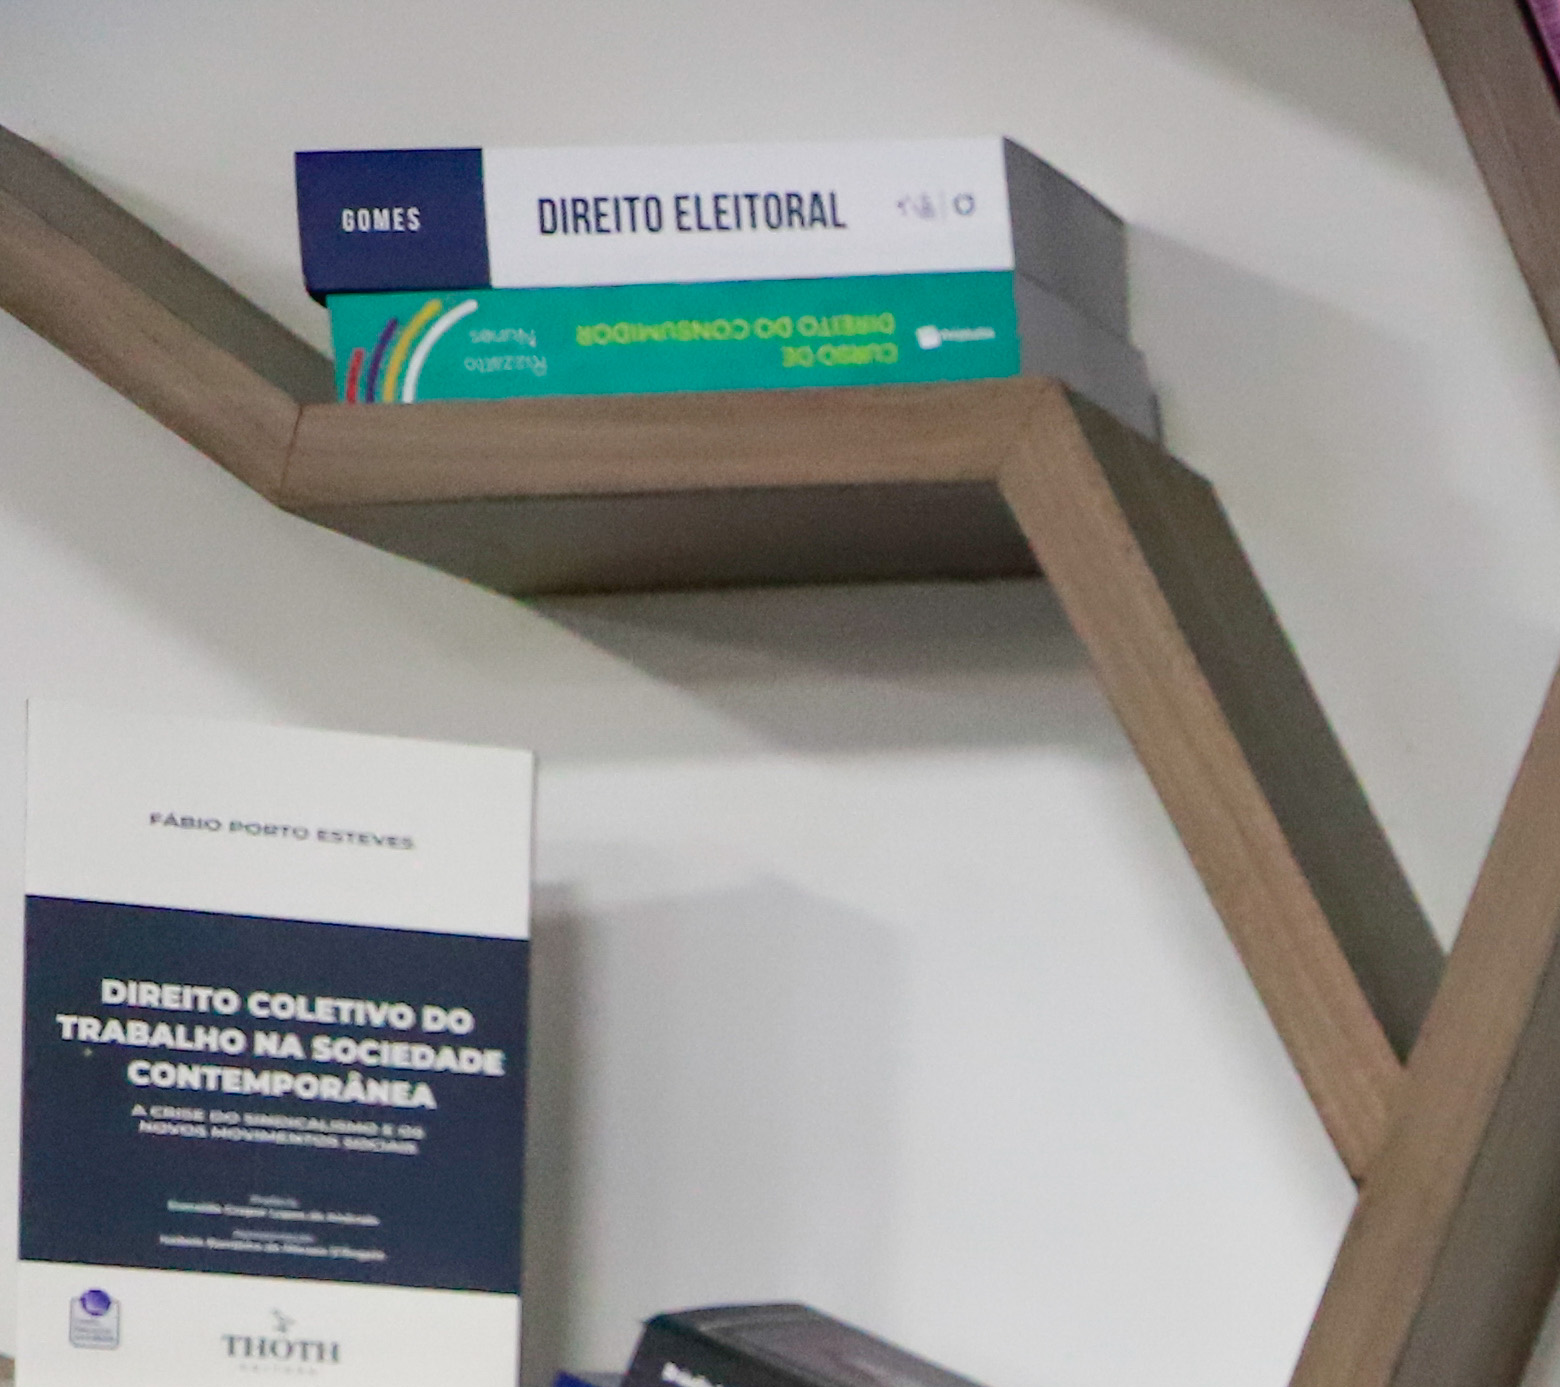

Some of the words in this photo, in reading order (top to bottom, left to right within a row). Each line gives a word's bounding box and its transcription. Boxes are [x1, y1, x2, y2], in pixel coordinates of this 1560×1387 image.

[341, 206, 421, 233] GOMES
[538, 195, 664, 236] DIREITO
[674, 190, 848, 232] ELEITORAL
[575, 318, 749, 346] CONSUMIDOR
[754, 316, 793, 339] DO
[797, 311, 895, 337] DIREITO
[782, 345, 815, 368] DE
[149, 812, 222, 832] FÁBIO
[229, 820, 309, 841] PORTO
[316, 829, 416, 851] ESTEVES
[101, 978, 242, 1016] DIREITO
[247, 989, 417, 1031] COLETIVO
[421, 1004, 476, 1036] DO
[55, 1013, 248, 1056] TRABALHO
[252, 1029, 307, 1061] NA
[310, 1034, 506, 1078] SOCIEDADE
[126, 1058, 438, 1110] CONTEMPORÂNEA
[221, 1333, 340, 1365] THOTH
